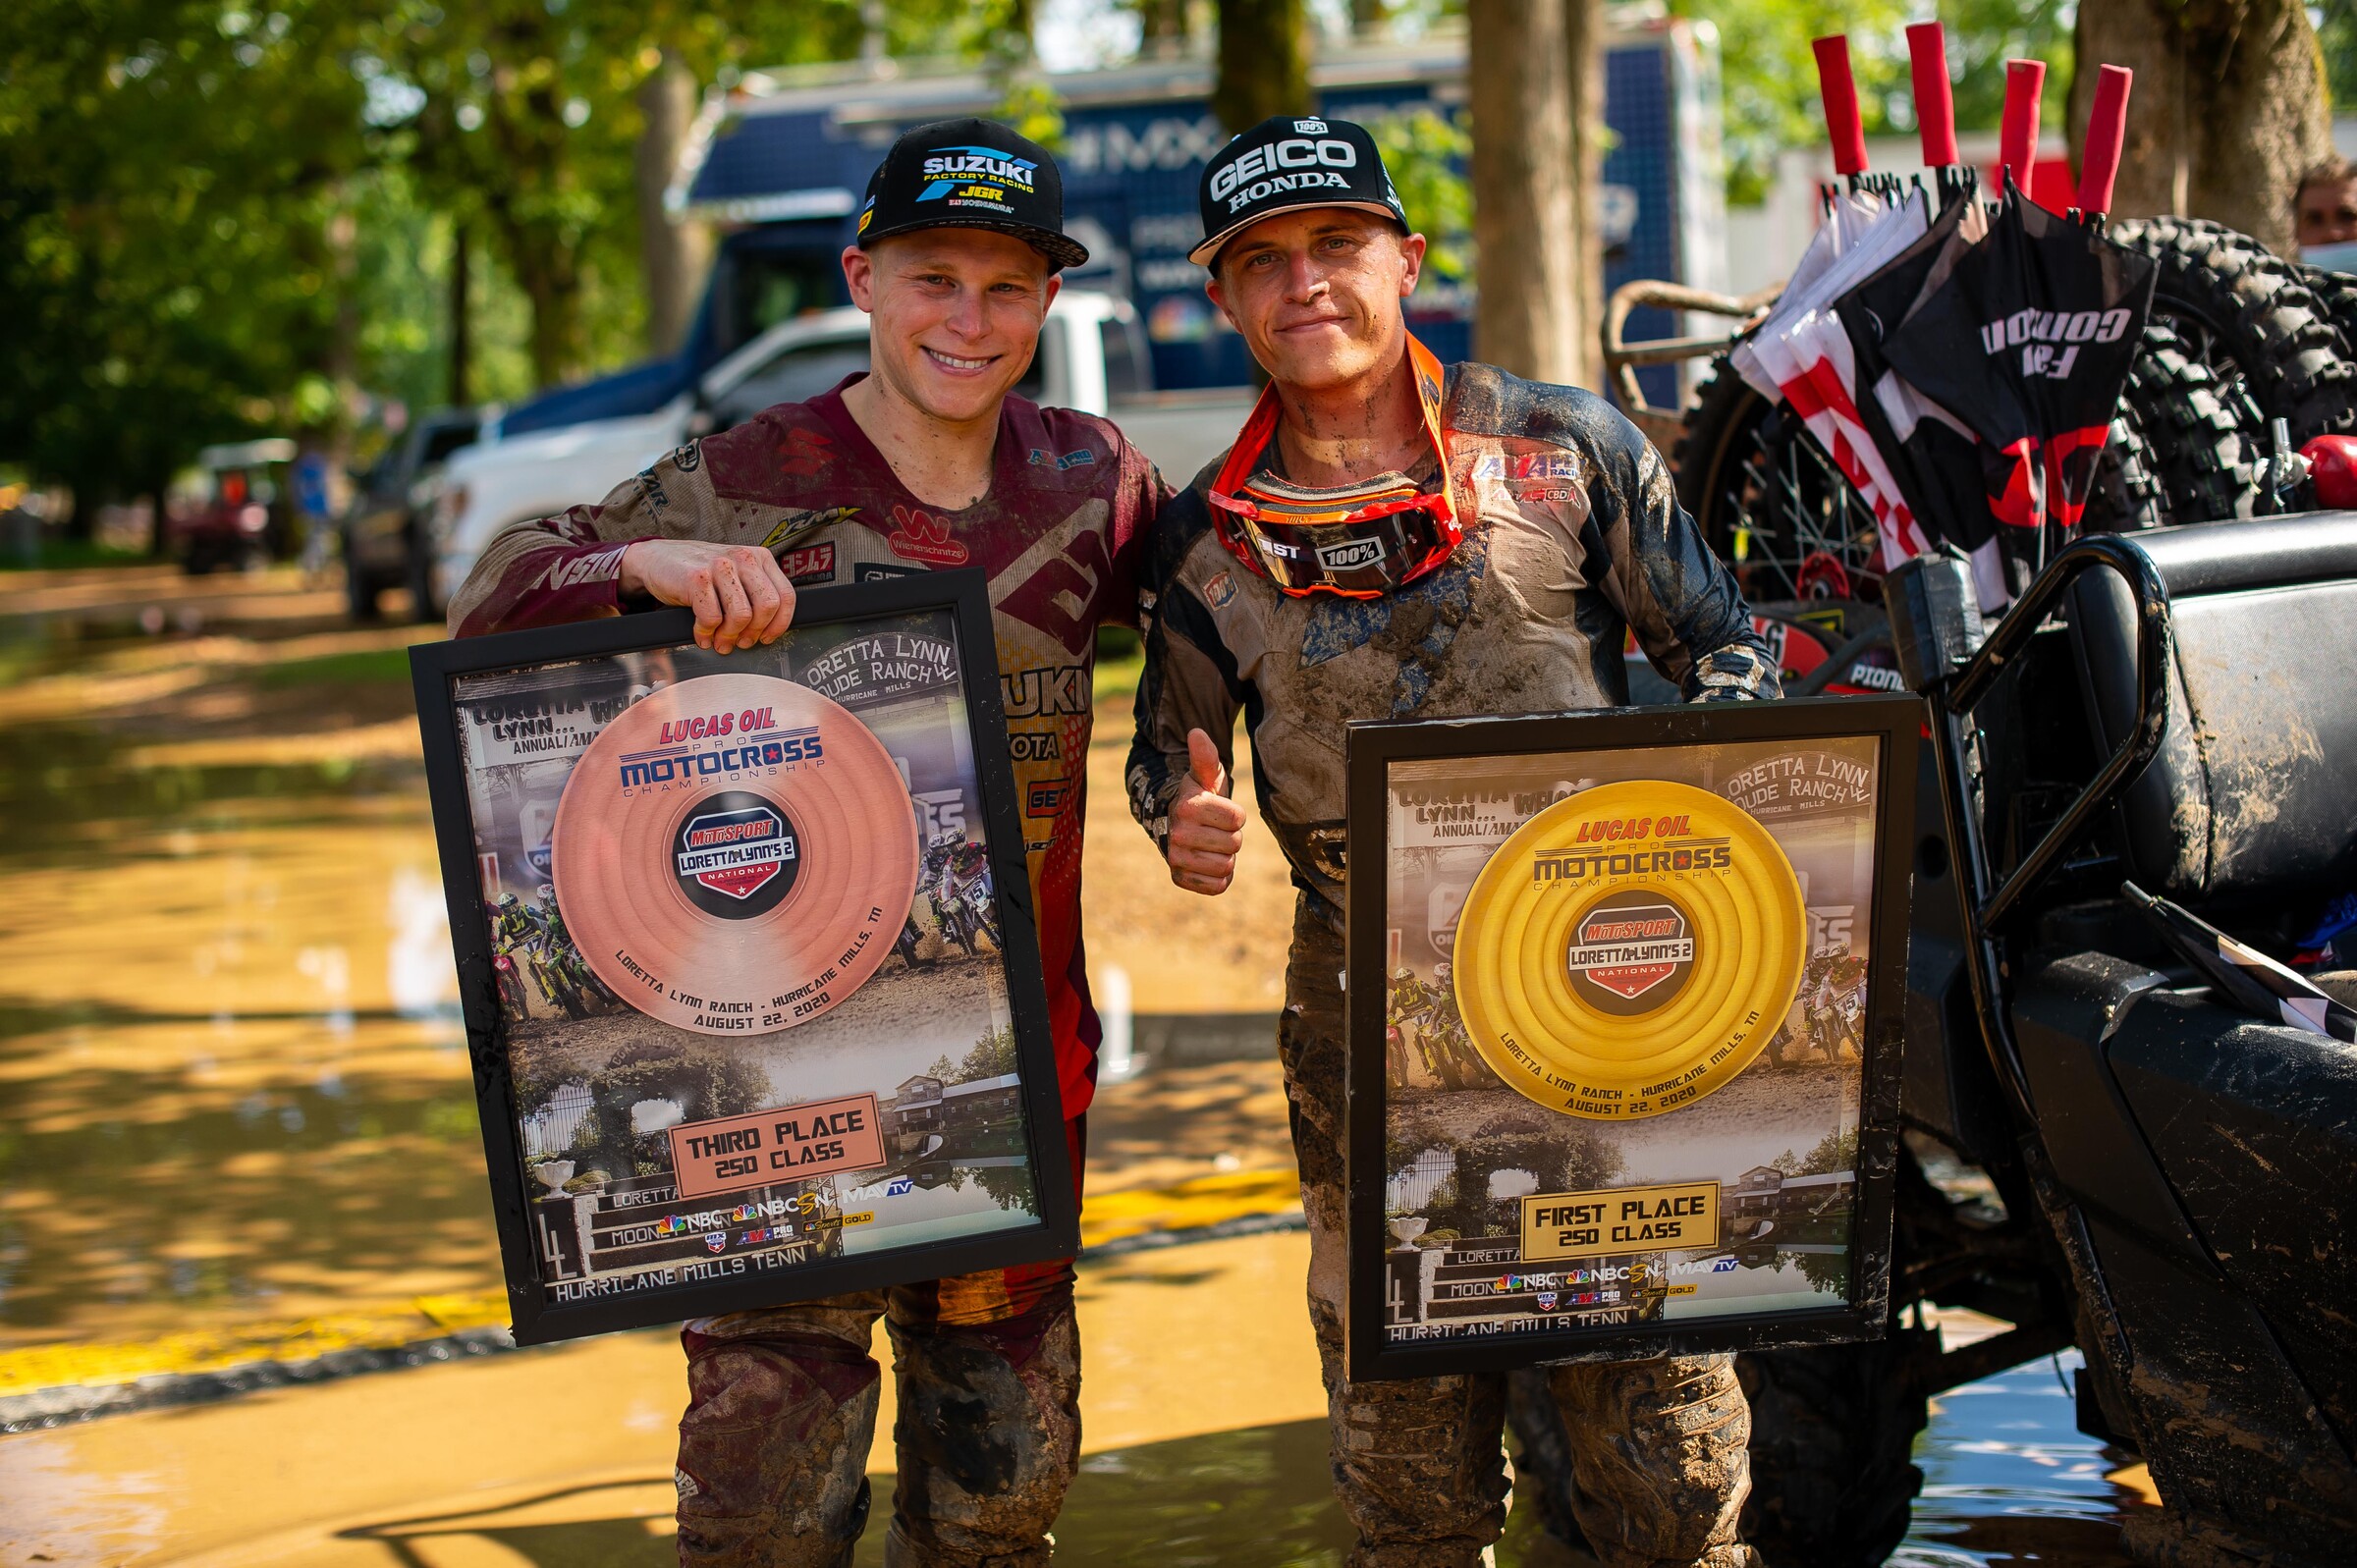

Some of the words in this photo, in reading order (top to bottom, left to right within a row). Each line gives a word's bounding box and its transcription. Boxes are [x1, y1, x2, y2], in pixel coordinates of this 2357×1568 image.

[1299, 123, 1324, 132] 100%
[923, 156, 1032, 186] SUZUKI
[923, 172, 984, 181] FACTORY
[989, 176, 1035, 193] RACING
[1210, 138, 1357, 202] GEICO
[959, 186, 1004, 201] JGR
[1229, 172, 1351, 214] HONDA
[1547, 489, 1568, 501] CBD
[894, 539, 966, 559] Wienerschnitzel
[1327, 543, 1376, 567] 100%
[806, 639, 885, 686] ORETTA
[895, 634, 952, 667] LYNN
[871, 662, 933, 684] RANCH
[1850, 664, 1906, 691] PION
[836, 689, 878, 704] HURRICANE
[886, 680, 911, 693] MILLS
[659, 712, 735, 744] LUCAS
[739, 706, 778, 732] OIL
[691, 736, 746, 752] PRO
[620, 735, 824, 787] MOTOCROSS
[623, 759, 826, 798] CHAMPIONSHIP
[1727, 757, 1805, 801] ORETTA
[1816, 754, 1869, 787] LYNN
[1030, 788, 1069, 808] GET
[1788, 778, 1848, 804] RANCH
[1750, 805, 1792, 816] HURRICANE
[1799, 799, 1825, 810] MILLS
[1575, 820, 1652, 842] LUCAS
[1655, 815, 1690, 838] OIL
[680, 851, 739, 872] LORETTA
[740, 843, 783, 864] LYNN'S
[785, 840, 794, 856] 2
[1607, 841, 1660, 853] PRO
[708, 864, 772, 881] NATIONAL
[1533, 846, 1731, 882] MOTOCROSS
[1533, 869, 1731, 892] CHAMPIONSHIP
[615, 949, 664, 994] LORETTA
[669, 989, 704, 1010] LYNN
[709, 1001, 753, 1014] RANCH
[772, 966, 839, 1009] HURRICANE
[838, 931, 873, 968] MILLS,
[867, 905, 883, 924] TN
[1571, 946, 1630, 965] LORETTA
[1633, 943, 1680, 961] LYNN'S
[1682, 942, 1692, 957] 2
[1597, 966, 1666, 977] NATIONAL
[693, 1013, 755, 1030] AUGUST
[762, 1015, 789, 1027] 22,
[794, 991, 832, 1018] 2020
[1500, 1032, 1542, 1077] LORETTA
[1545, 1072, 1576, 1094] LYNN
[1581, 1086, 1622, 1101] RANCH
[1641, 1063, 1708, 1098] HURRICANE
[1709, 1031, 1747, 1065] MILLS,
[1744, 1009, 1761, 1027] TN
[1563, 1097, 1622, 1115] AUGUST
[1629, 1100, 1654, 1113] 22,
[1660, 1085, 1698, 1108] 2020
[685, 1127, 762, 1160] THIRD
[774, 1108, 865, 1145] PLACE
[714, 1155, 759, 1178] 250
[770, 1140, 846, 1169] CLASS
[686, 1209, 723, 1228] NBC
[757, 1192, 832, 1217] NBCSN
[1535, 1203, 1608, 1228] FIRST
[1620, 1195, 1707, 1221] PLACE
[737, 1227, 773, 1246] AMA
[773, 1224, 794, 1235] PRO
[844, 1214, 871, 1225] GOLD
[1559, 1228, 1600, 1247] 250
[1611, 1221, 1682, 1243] CLASS
[683, 1258, 746, 1282] MILLS
[751, 1245, 806, 1271] TENN
[1458, 1250, 1520, 1265] LORETTA
[1523, 1272, 1557, 1288] NBC
[1591, 1264, 1659, 1283] NBCSN
[1565, 1292, 1602, 1306] AMA
[1602, 1290, 1620, 1299] PRO
[1669, 1286, 1695, 1296] GOLD
[1577, 1310, 1628, 1327] TENN
